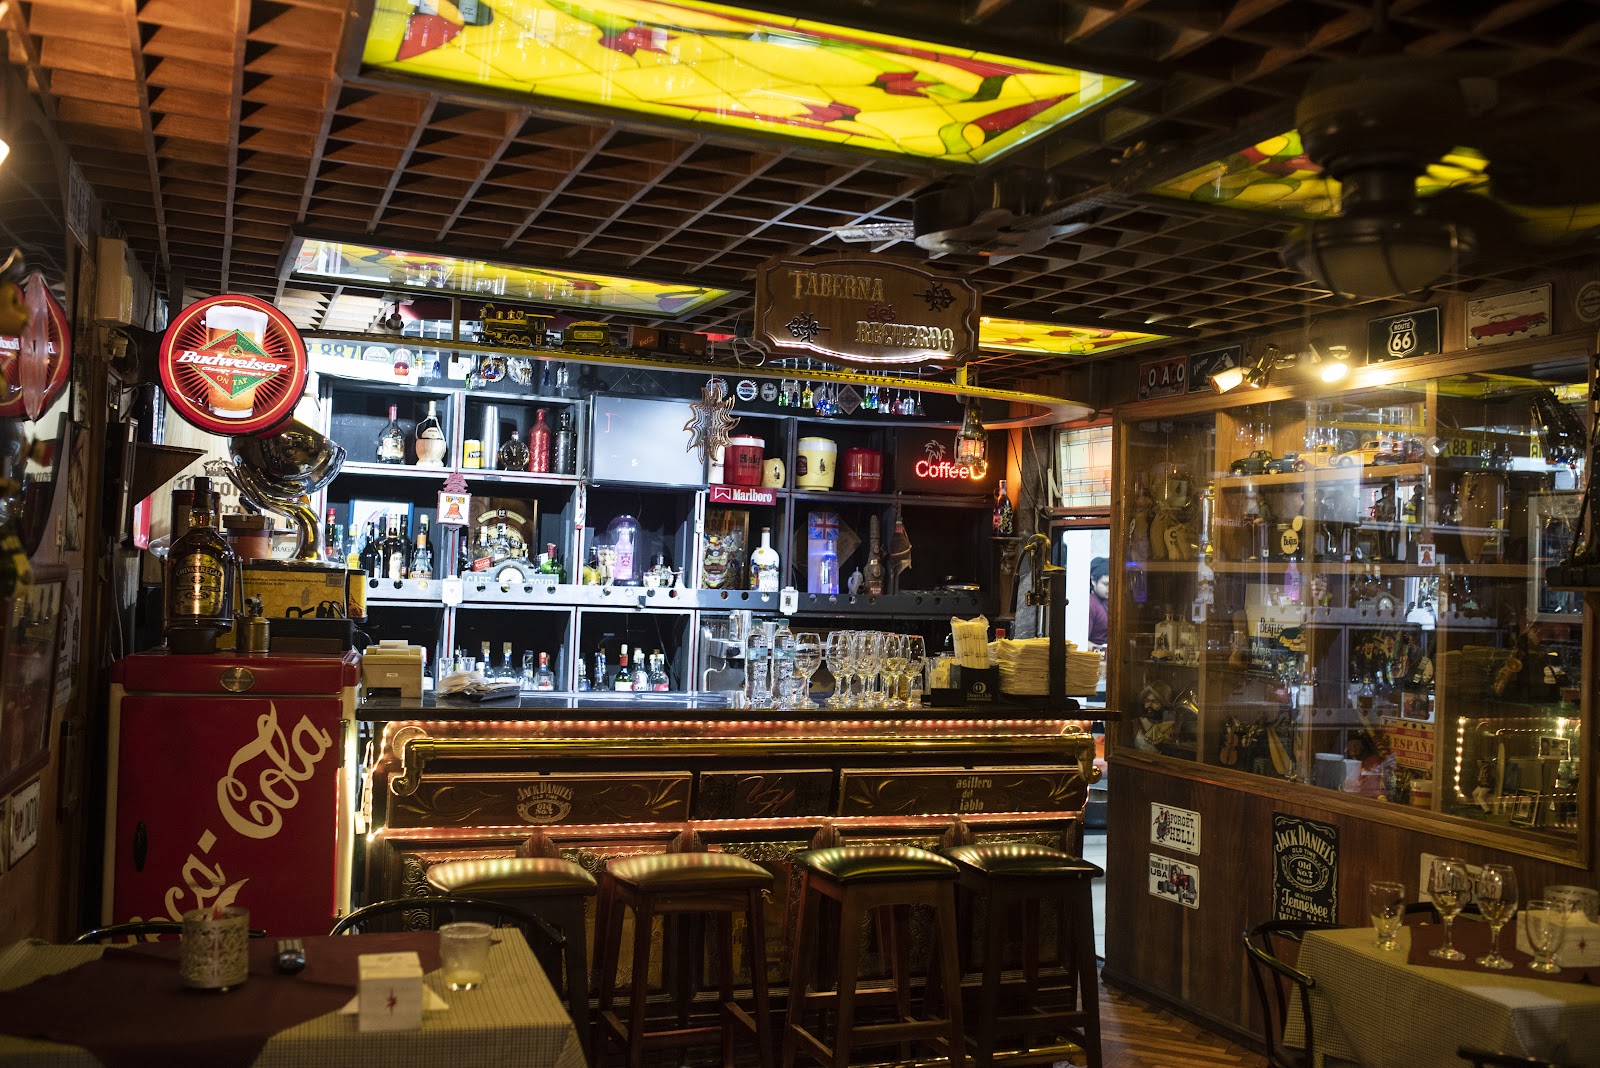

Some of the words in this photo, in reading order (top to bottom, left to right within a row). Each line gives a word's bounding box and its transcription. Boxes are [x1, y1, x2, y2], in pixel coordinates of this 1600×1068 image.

[788, 270, 884, 302] TABERNA
[855, 320, 955, 351] RECUERDO
[1393, 321, 1411, 331] ROUTE
[1392, 331, 1412, 351] 66
[176, 350, 288, 373] Budweiser
[216, 375, 229, 385] ON
[232, 377, 249, 387] TAP
[740, 453, 761, 467] Haig
[915, 460, 970, 479] Coffee
[732, 488, 773, 503] Marlboro
[175, 566, 200, 577] CHIVAS
[200, 566, 222, 578] REGAL
[1259, 617, 1284, 637] BEATLES
[1393, 737, 1434, 754] ESPAÑA
[517, 784, 539, 801] JACK
[539, 781, 575, 801] DANIEL'S
[1169, 826, 1195, 846] HELL!
[1275, 829, 1299, 852] JACK
[1298, 824, 1336, 866] DANIEL'S
[1150, 867, 1168, 879] USA
[1297, 860, 1312, 871] Old
[1280, 905, 1302, 918] SOUR
[1281, 887, 1328, 918] Tennessee
